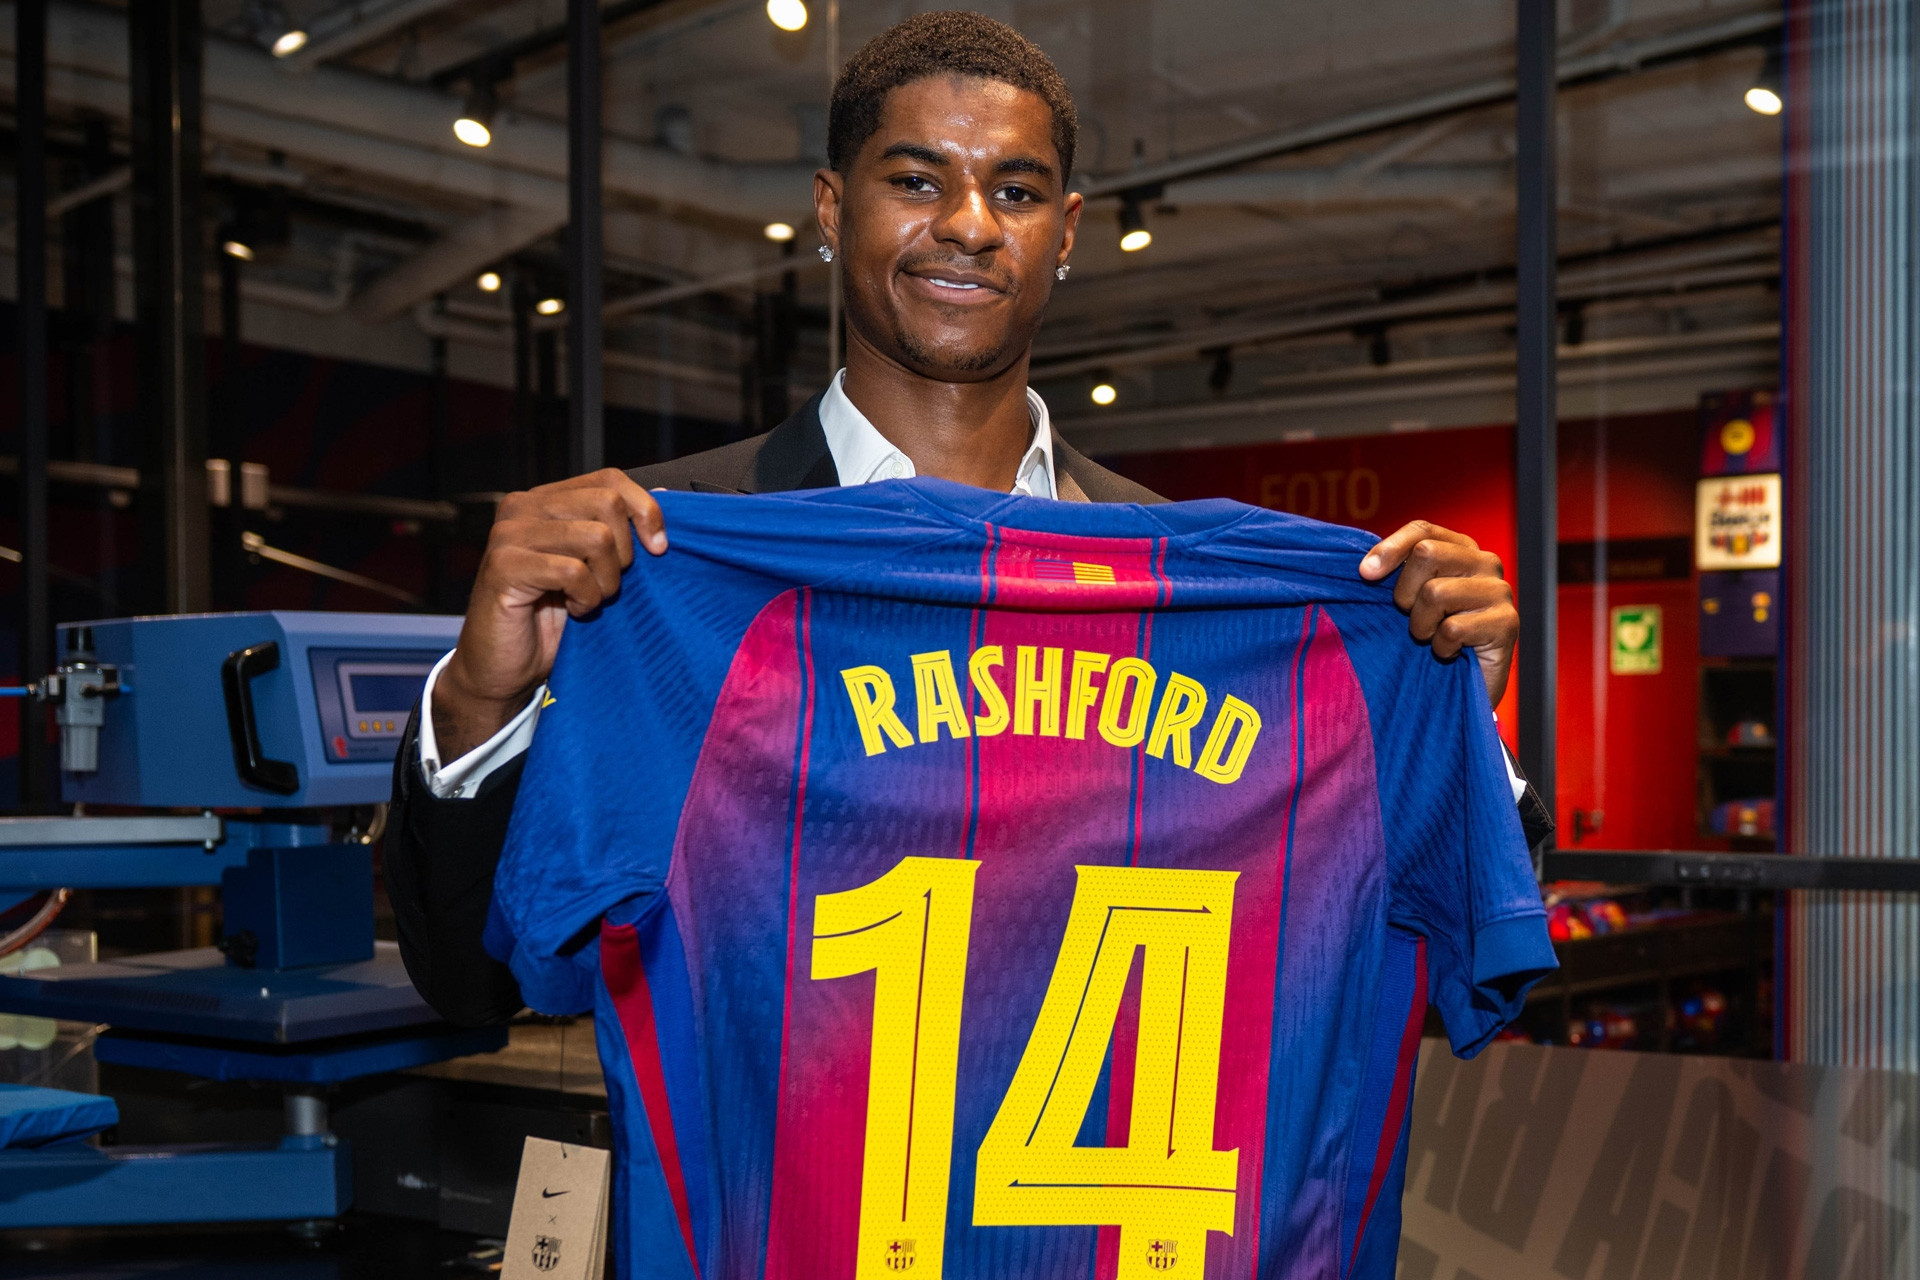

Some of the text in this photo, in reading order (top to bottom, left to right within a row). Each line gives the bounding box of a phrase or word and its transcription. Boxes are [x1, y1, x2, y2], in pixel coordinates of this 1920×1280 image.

[1261, 468, 1380, 519] FOTO
[840, 645, 1262, 784] RASHFORD
[810, 856, 1241, 1280] 14
